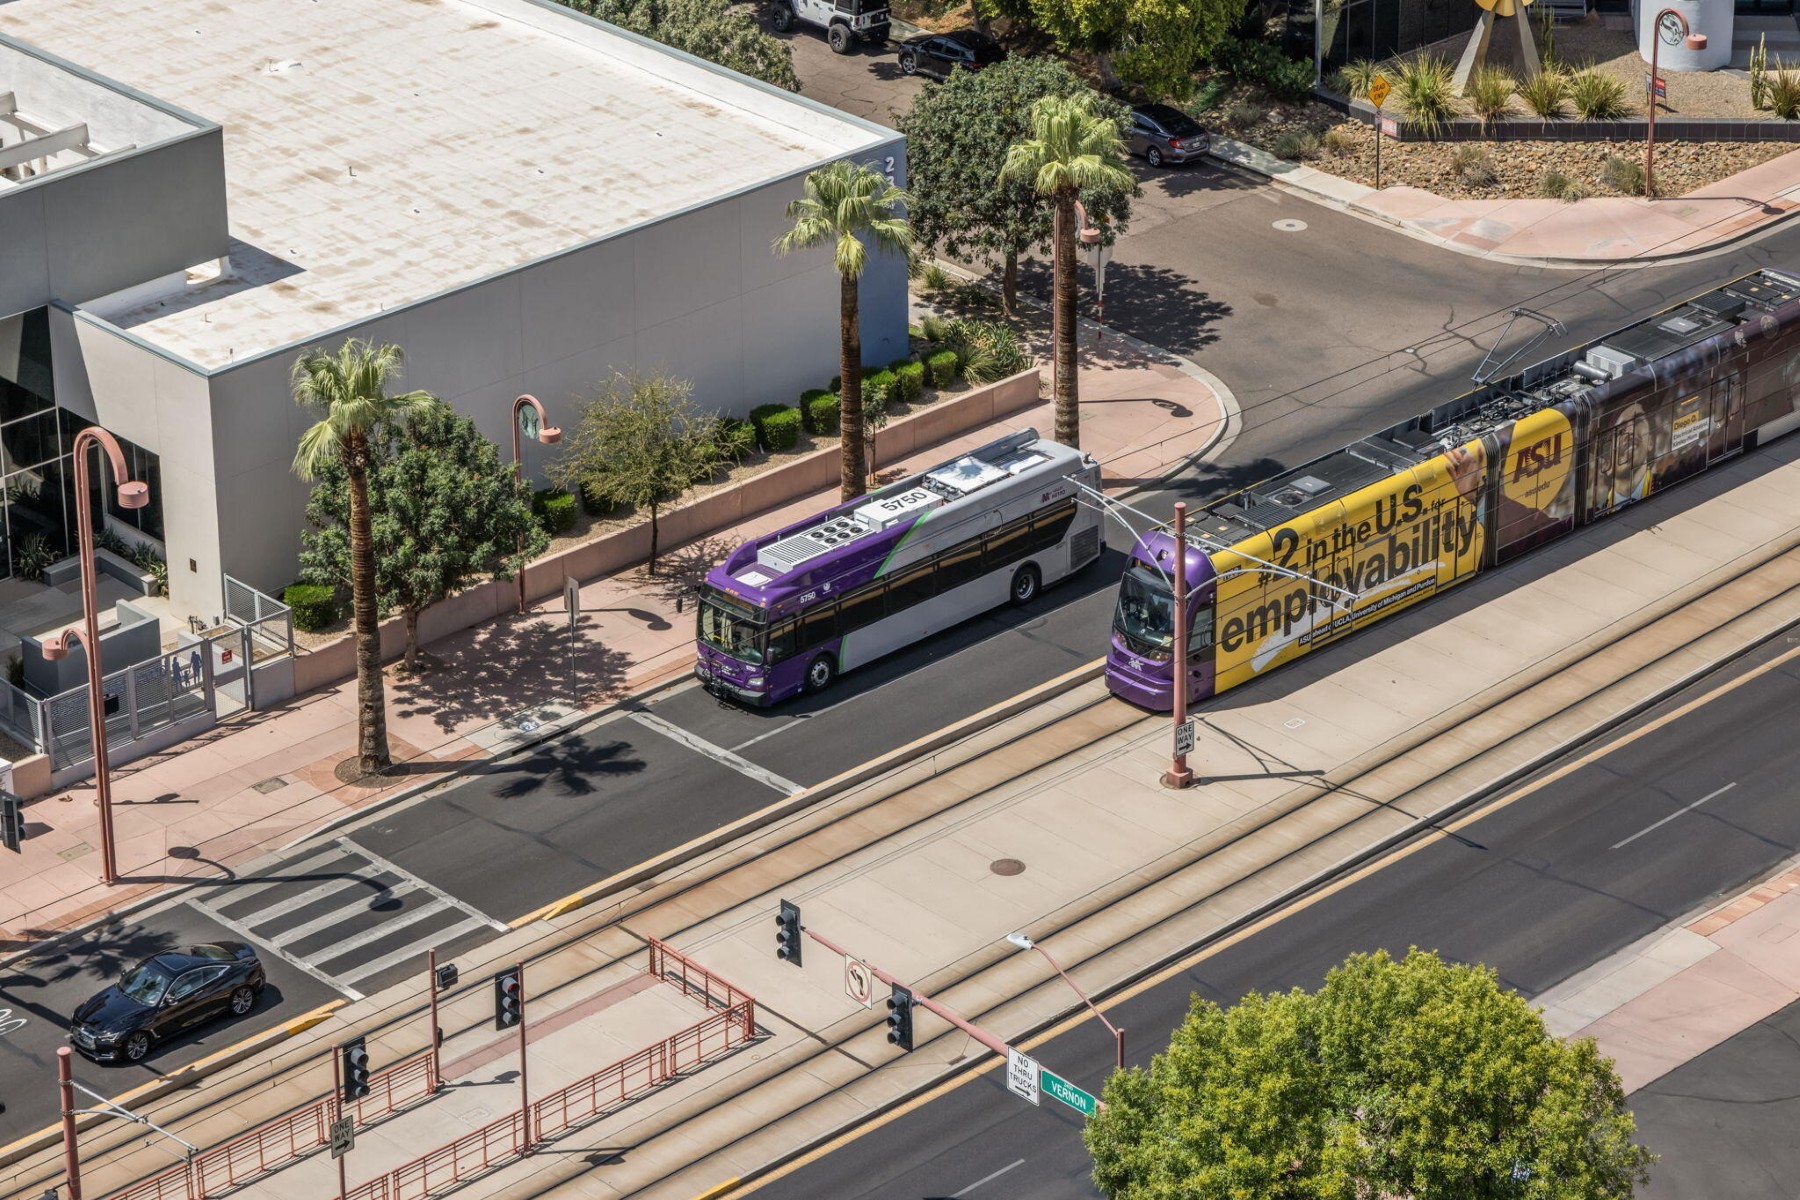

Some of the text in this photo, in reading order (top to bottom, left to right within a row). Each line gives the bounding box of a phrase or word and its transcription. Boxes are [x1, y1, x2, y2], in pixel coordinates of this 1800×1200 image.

[1513, 433, 1562, 484] ASU
[881, 492, 927, 511] 5750
[1306, 538, 1327, 567] in
[1332, 521, 1371, 555] the
[1376, 483, 1428, 535] U.S.
[1221, 509, 1478, 653] employability
[801, 592, 816, 603] 5750
[1351, 604, 1377, 620] University
[1383, 589, 1406, 605] Michigan
[1407, 584, 1417, 595] and
[1417, 578, 1435, 590] Purdue
[1178, 724, 1192, 736] ONE
[1178, 732, 1193, 745] WAY
[1018, 1056, 1029, 1068] NO
[1014, 1064, 1033, 1080] THRU
[1009, 1071, 1037, 1093] TRUCKS
[1051, 1080, 1087, 1110] VERNON
[334, 1120, 350, 1134] ONE
[334, 1129, 350, 1142] WAY
